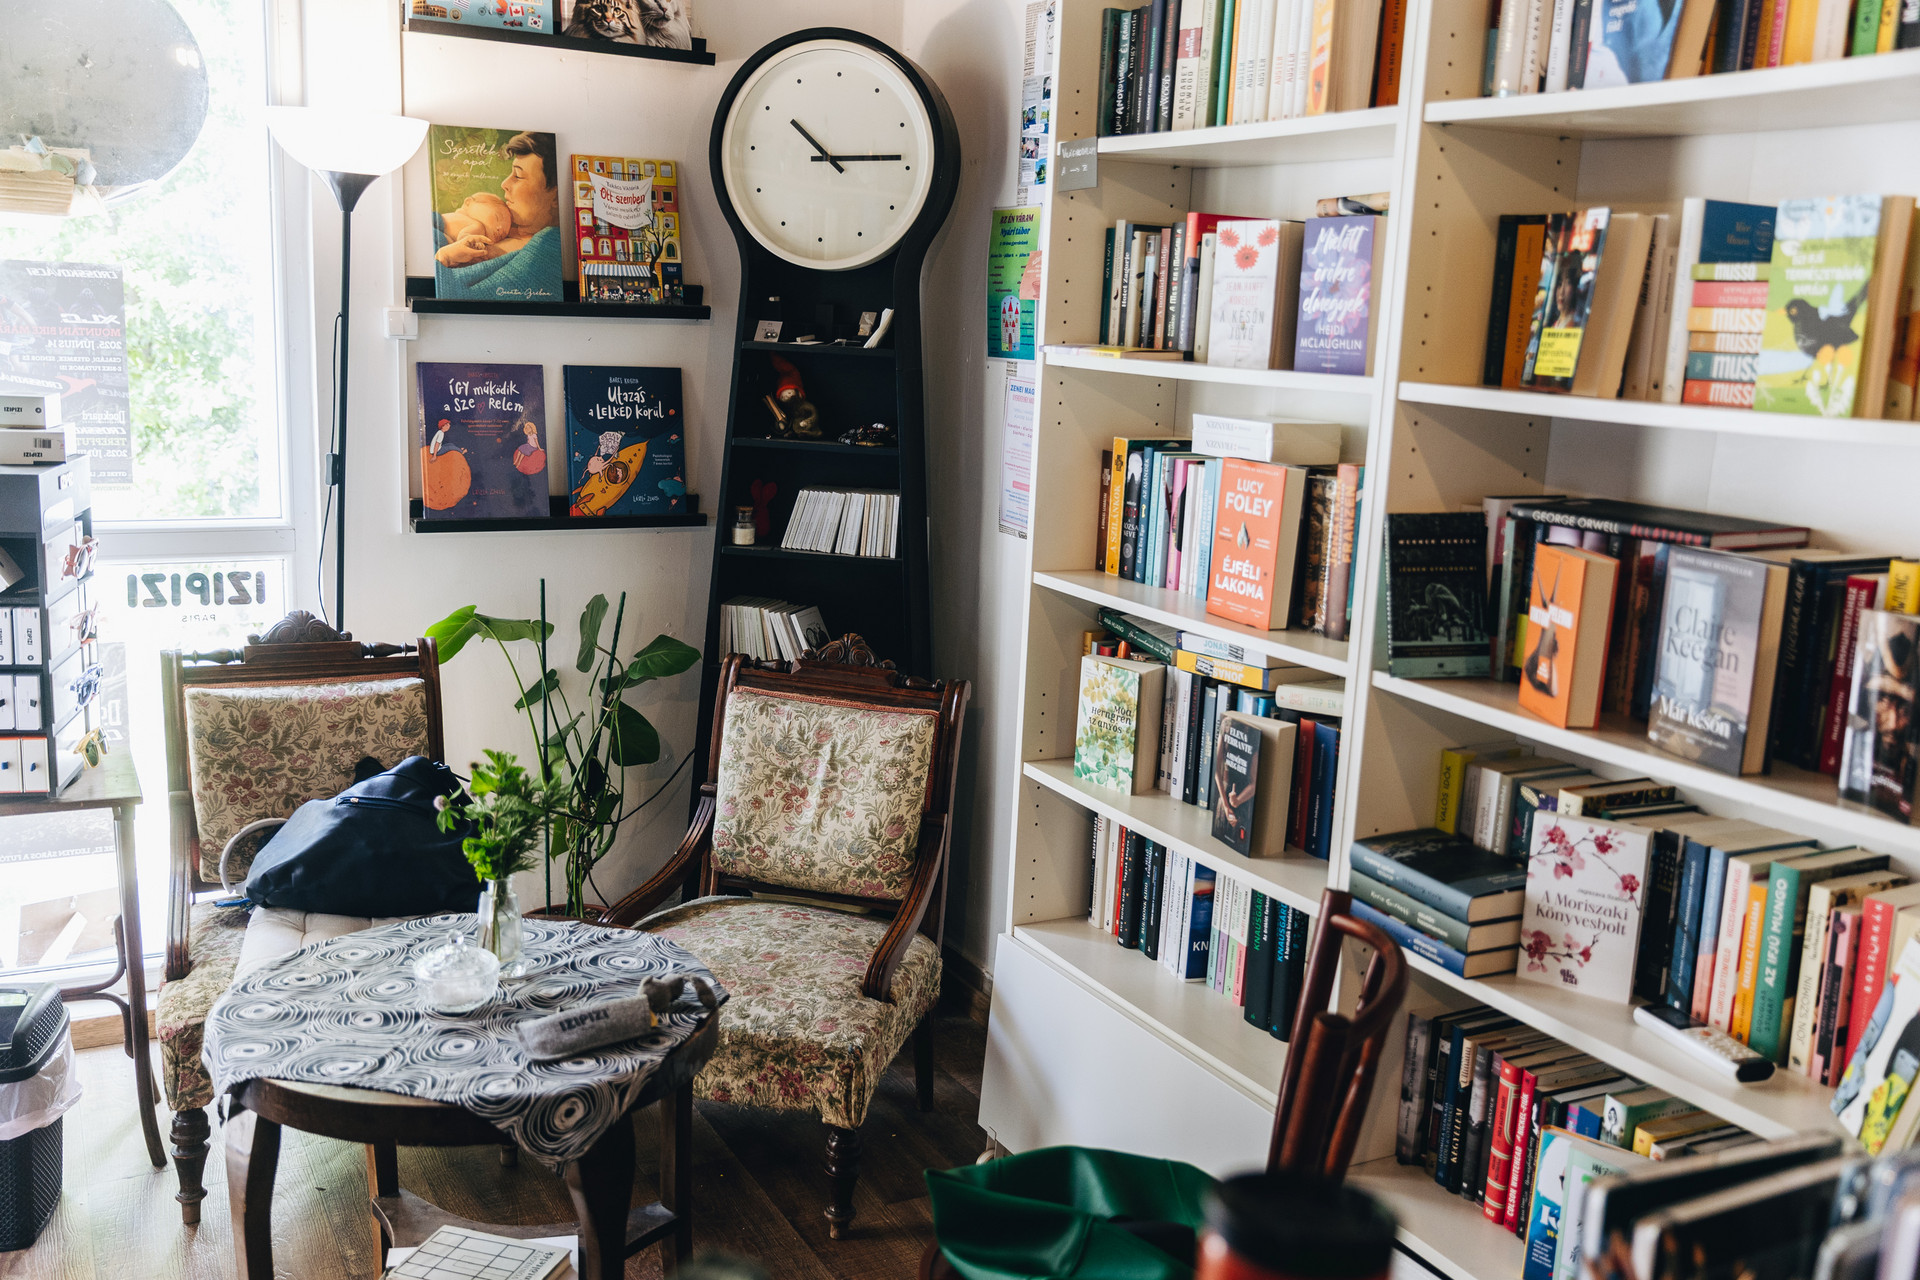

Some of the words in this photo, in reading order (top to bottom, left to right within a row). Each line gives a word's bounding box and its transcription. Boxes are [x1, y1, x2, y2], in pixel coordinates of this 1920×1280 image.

[1161, 74, 1171, 118] ATWOOD
[1178, 65, 1188, 119] MARGARET
[1184, 71, 1193, 112] ATWOOD
[440, 139, 501, 162] Szeretlek,
[463, 157, 493, 172] apa!
[600, 187, 613, 203] Ott
[616, 194, 645, 205] szemben
[1000, 228, 1016, 238] Nyári
[1018, 227, 1030, 235] tábor
[1220, 313, 1225, 322] A
[1302, 288, 1364, 323] elmegyek
[1318, 325, 1343, 335] HEIDI
[1300, 338, 1362, 350] MCLAUGHLIN
[449, 378, 469, 396] ÍGY
[473, 381, 520, 396] működik
[608, 386, 646, 403] Utazás
[444, 402, 450, 412] a
[588, 408, 594, 416] a
[596, 403, 632, 420] LELKED
[636, 402, 664, 419] körül
[1142, 489, 1148, 499] AZ
[1236, 478, 1264, 495] LUCY
[1111, 484, 1121, 543] SZILÁNKOK
[1224, 491, 1273, 518] FOLEY
[1342, 485, 1356, 563] FRANZEN
[1532, 510, 1575, 527] GEORGE
[1577, 517, 1619, 534] ORWELL
[1222, 554, 1260, 580] ÉJFÉLI
[1214, 574, 1264, 601] LAKOMA
[1675, 604, 1736, 646] Claire
[1204, 640, 1228, 651] JONAS
[1666, 626, 1739, 674] Keegan
[1091, 706, 1132, 726] Herngren
[1114, 704, 1132, 717] Moa
[1659, 694, 1686, 720] Már
[1687, 706, 1731, 740] későn
[1099, 720, 1123, 735] anyós
[1229, 726, 1248, 743] ELENA
[1224, 732, 1253, 754] FERRANTE
[1442, 764, 1452, 785] IDŐK
[1440, 788, 1450, 823] VALÓS
[1541, 890, 1550, 904] A
[1555, 893, 1629, 922] Moriszaki
[1771, 878, 1787, 933] MUNGO
[1535, 903, 1627, 937] Könyvesbolt
[1767, 936, 1780, 964] IFJÚ
[1764, 968, 1775, 987] AZ
[1715, 991, 1726, 1014] CURTIS
[1756, 990, 1766, 1033] DOUGLAS
[559, 1008, 609, 1032] IZIPIZI
[1765, 998, 1774, 1032] STUART
[1461, 1046, 1471, 1084] Ullmann
[1451, 1107, 1463, 1163] KEGYELEM
[1511, 1146, 1522, 1188] WHITEHEAD
[1507, 1189, 1517, 1217] COLSON
